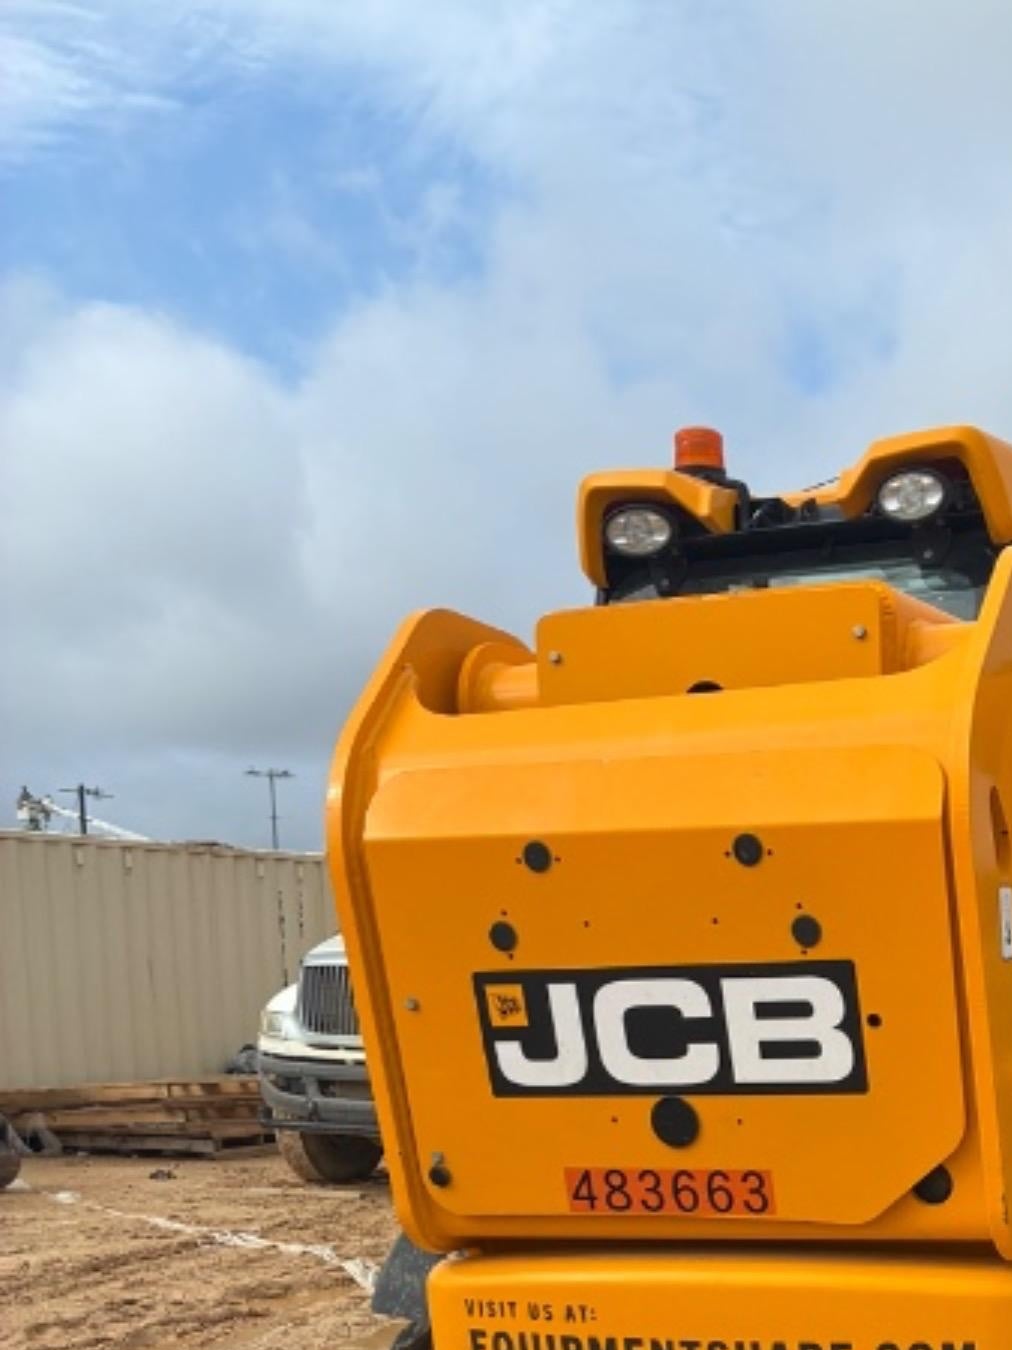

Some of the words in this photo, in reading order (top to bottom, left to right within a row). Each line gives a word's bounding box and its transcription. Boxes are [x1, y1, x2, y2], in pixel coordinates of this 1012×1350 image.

[494, 975, 854, 1087] JCB
[571, 1168, 769, 1213] 483663
[464, 1299, 516, 1320] VISIT
[528, 1302, 553, 1322] US
[564, 1304, 597, 1323] AT:
